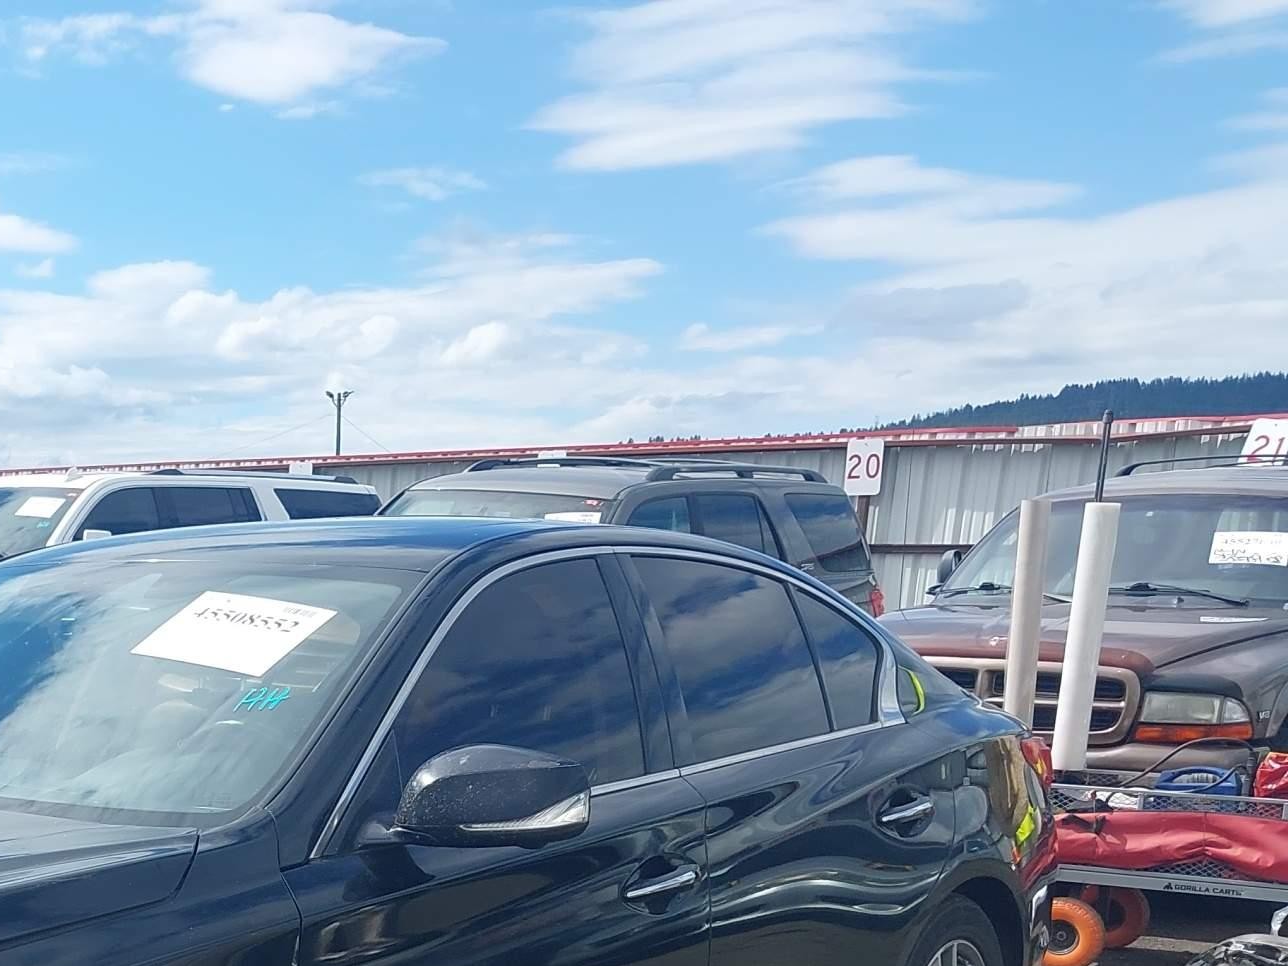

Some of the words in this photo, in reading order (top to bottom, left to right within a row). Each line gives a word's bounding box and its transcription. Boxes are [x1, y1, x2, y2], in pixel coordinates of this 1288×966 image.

[1246, 435, 1285, 464] 21
[847, 453, 880, 479] 20
[1174, 884, 1210, 893] GORILLA
